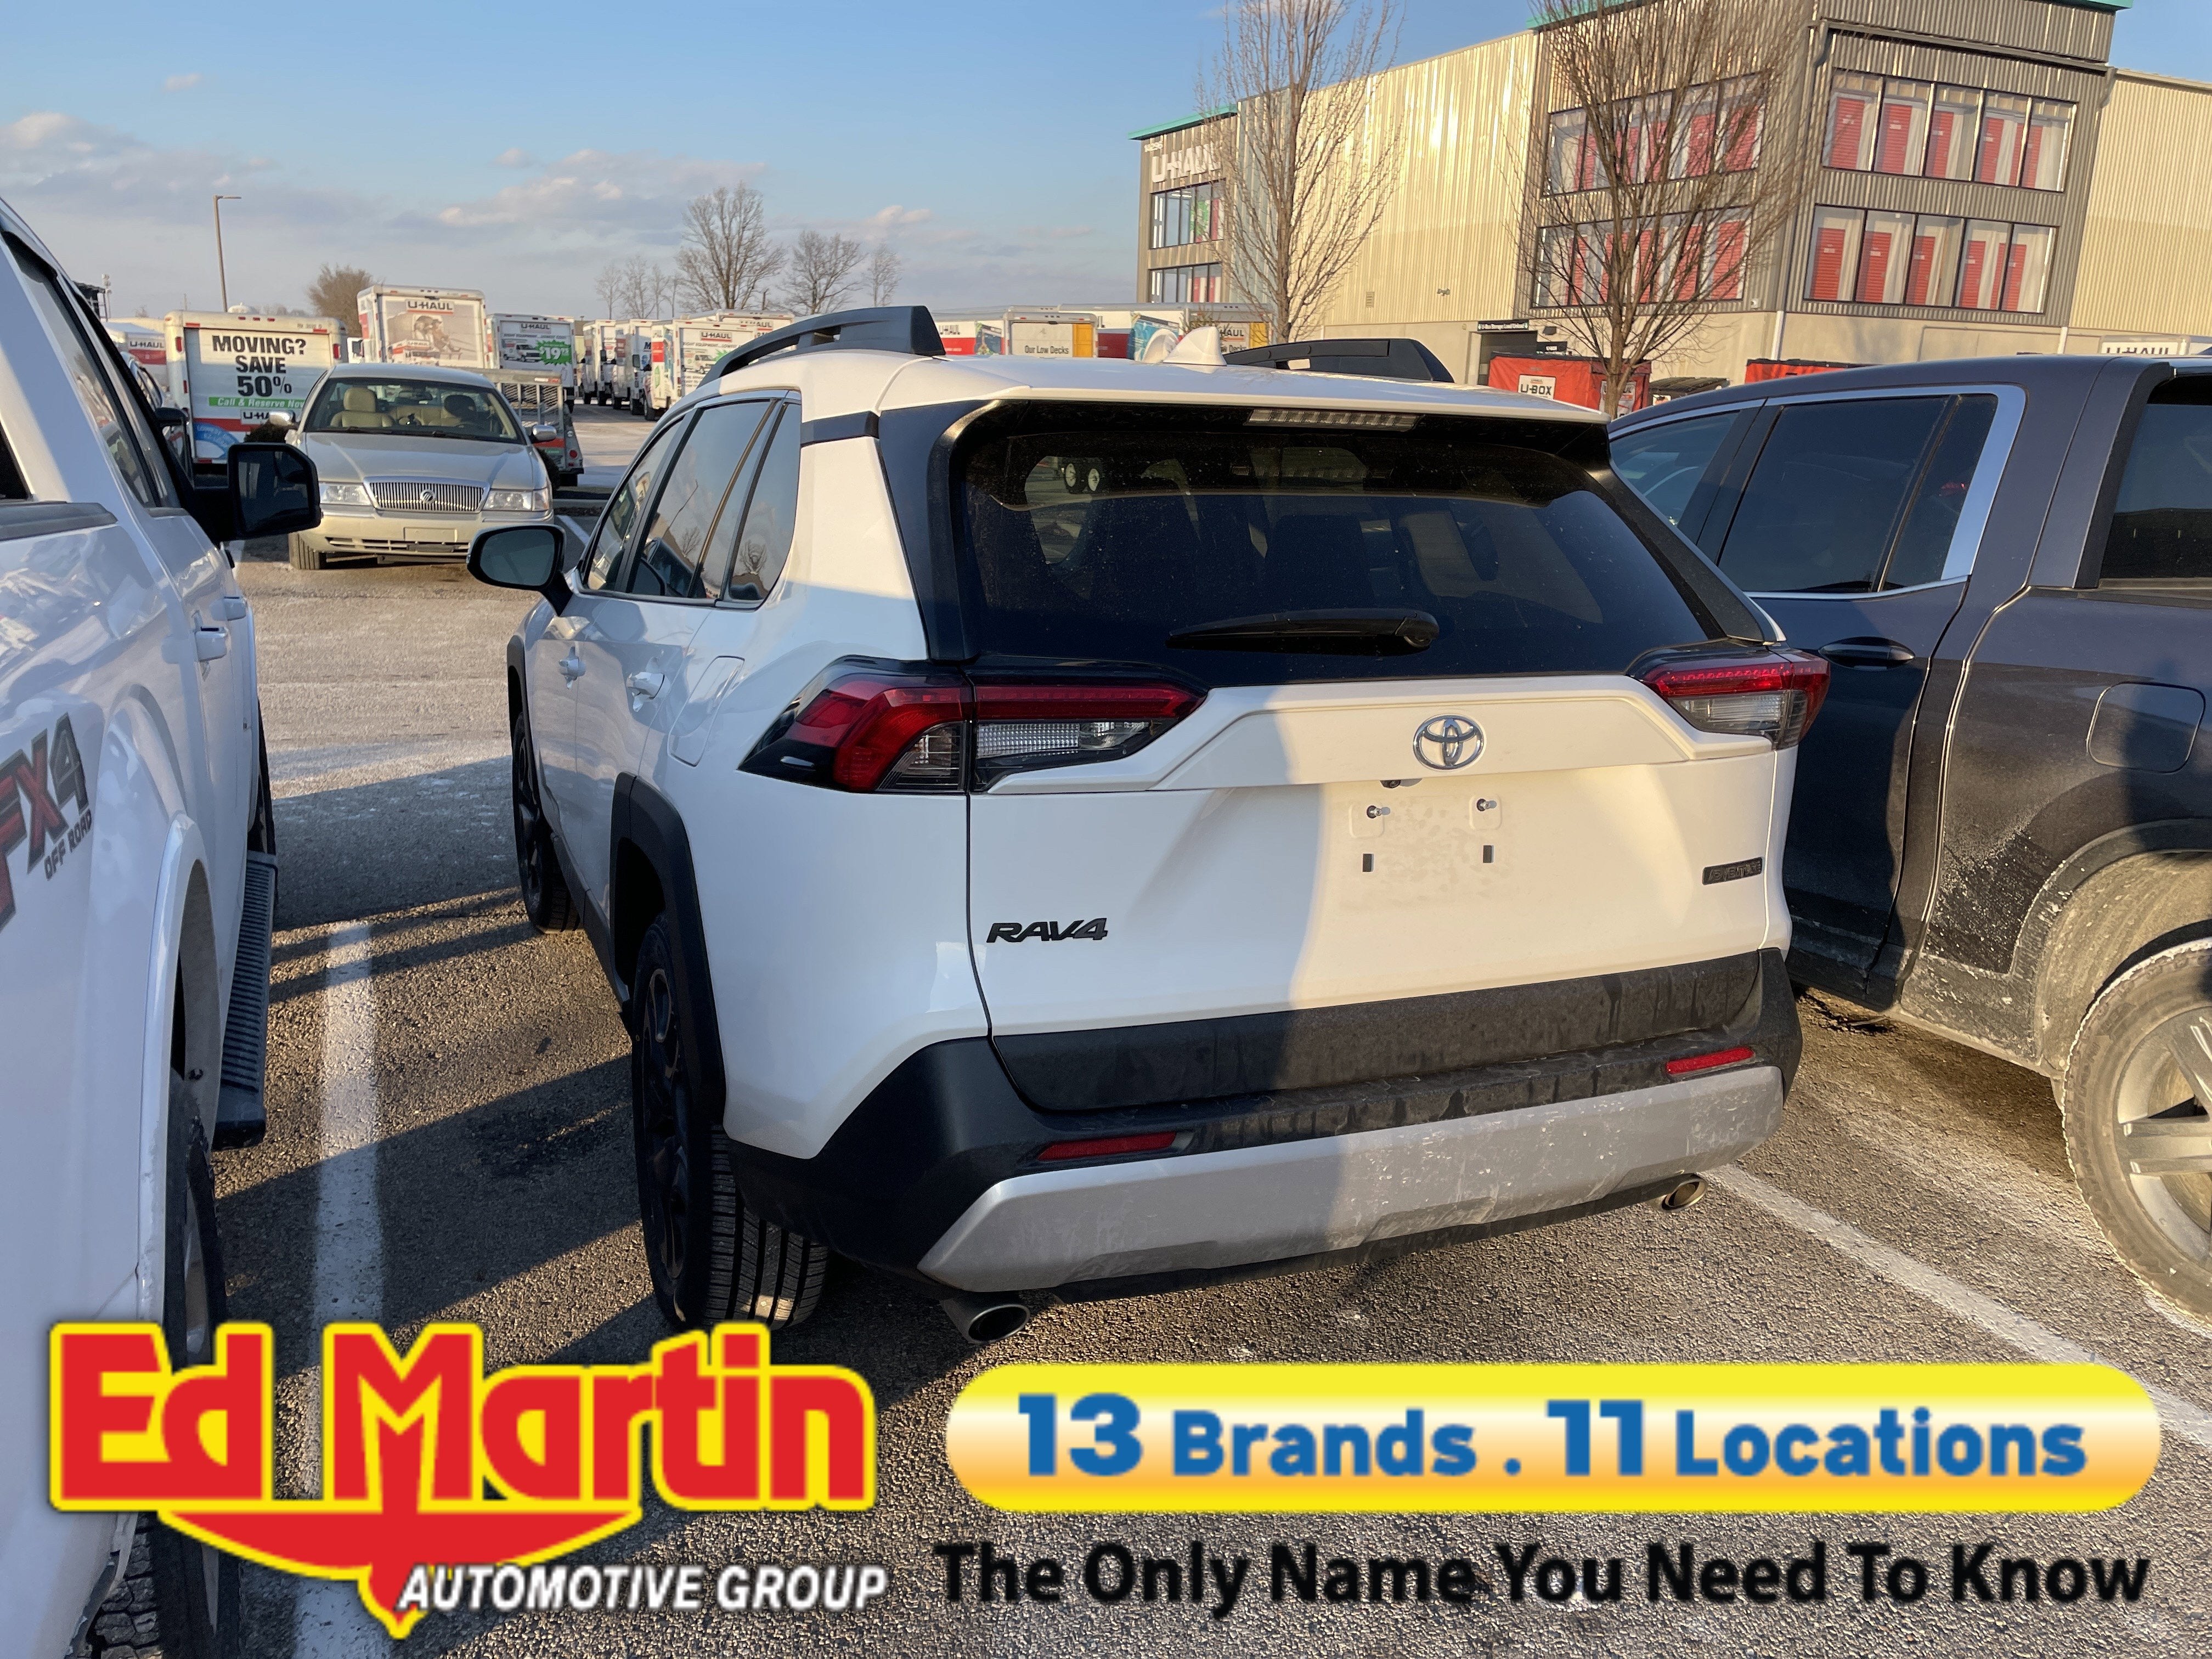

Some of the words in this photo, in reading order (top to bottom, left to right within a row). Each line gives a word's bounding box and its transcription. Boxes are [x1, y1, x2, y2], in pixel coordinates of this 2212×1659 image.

[408, 301, 453, 311] U-HAUL
[212, 335, 307, 355] MOVING?
[1024, 345, 1035, 353] Our
[1037, 345, 1048, 353] Low
[1050, 346, 1069, 354] Decks
[235, 356, 286, 374] SAVE
[237, 376, 292, 397] 50%
[1520, 383, 1553, 396] U-BOX
[218, 397, 236, 407] Call
[248, 399, 285, 408] Reserve
[44, 839, 66, 881] OFF
[67, 809, 92, 853] ROAD
[986, 917, 1108, 943] RAV4
